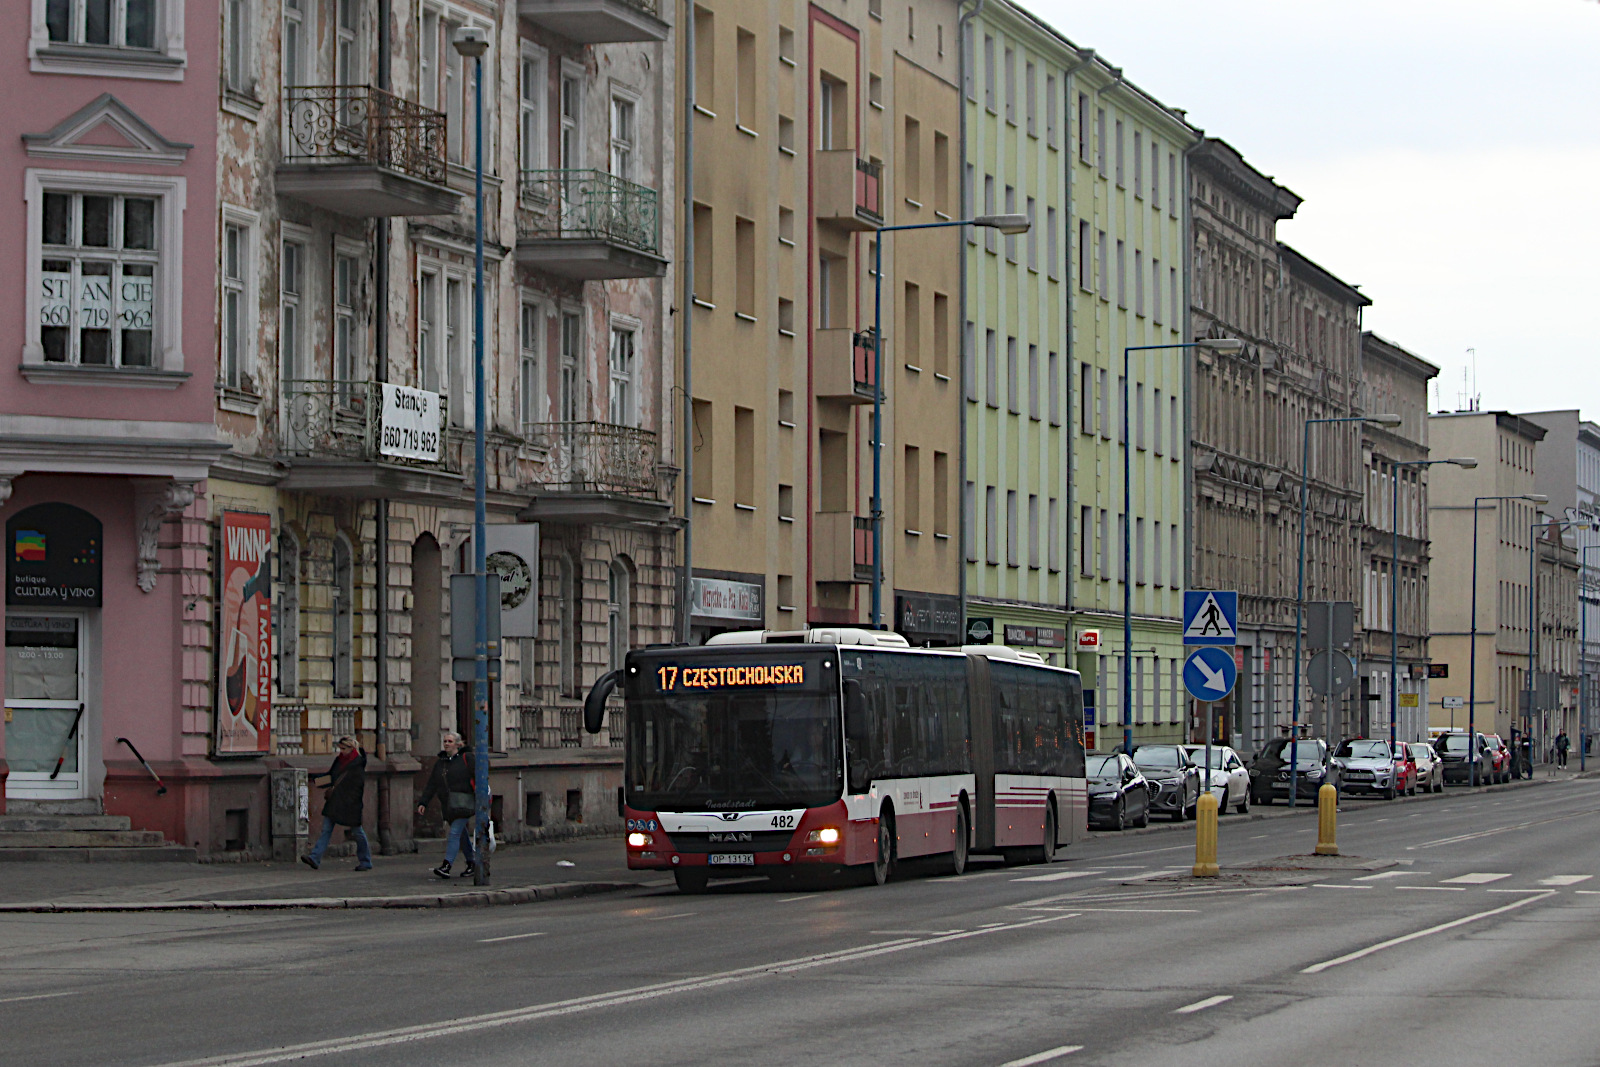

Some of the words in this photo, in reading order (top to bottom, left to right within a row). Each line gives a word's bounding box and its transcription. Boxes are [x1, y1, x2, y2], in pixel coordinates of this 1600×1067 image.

[41, 305, 70, 325] 660
[82, 308, 109, 327] 719
[124, 309, 152, 328] 962
[395, 387, 427, 418] Stancje
[384, 425, 401, 448] 660
[403, 428, 419, 451] 719
[421, 431, 437, 453] 962
[15, 575, 47, 583] butique
[15, 586, 58, 596] CULTURA
[69, 587, 95, 597] VINO
[259, 617, 269, 702] MOCNI
[658, 666, 678, 690] 17
[682, 665, 803, 688] CZĘSTOCHOWSKA
[770, 815, 794, 828] 482
[708, 832, 753, 842] MAN
[728, 853, 753, 865] 1313K
